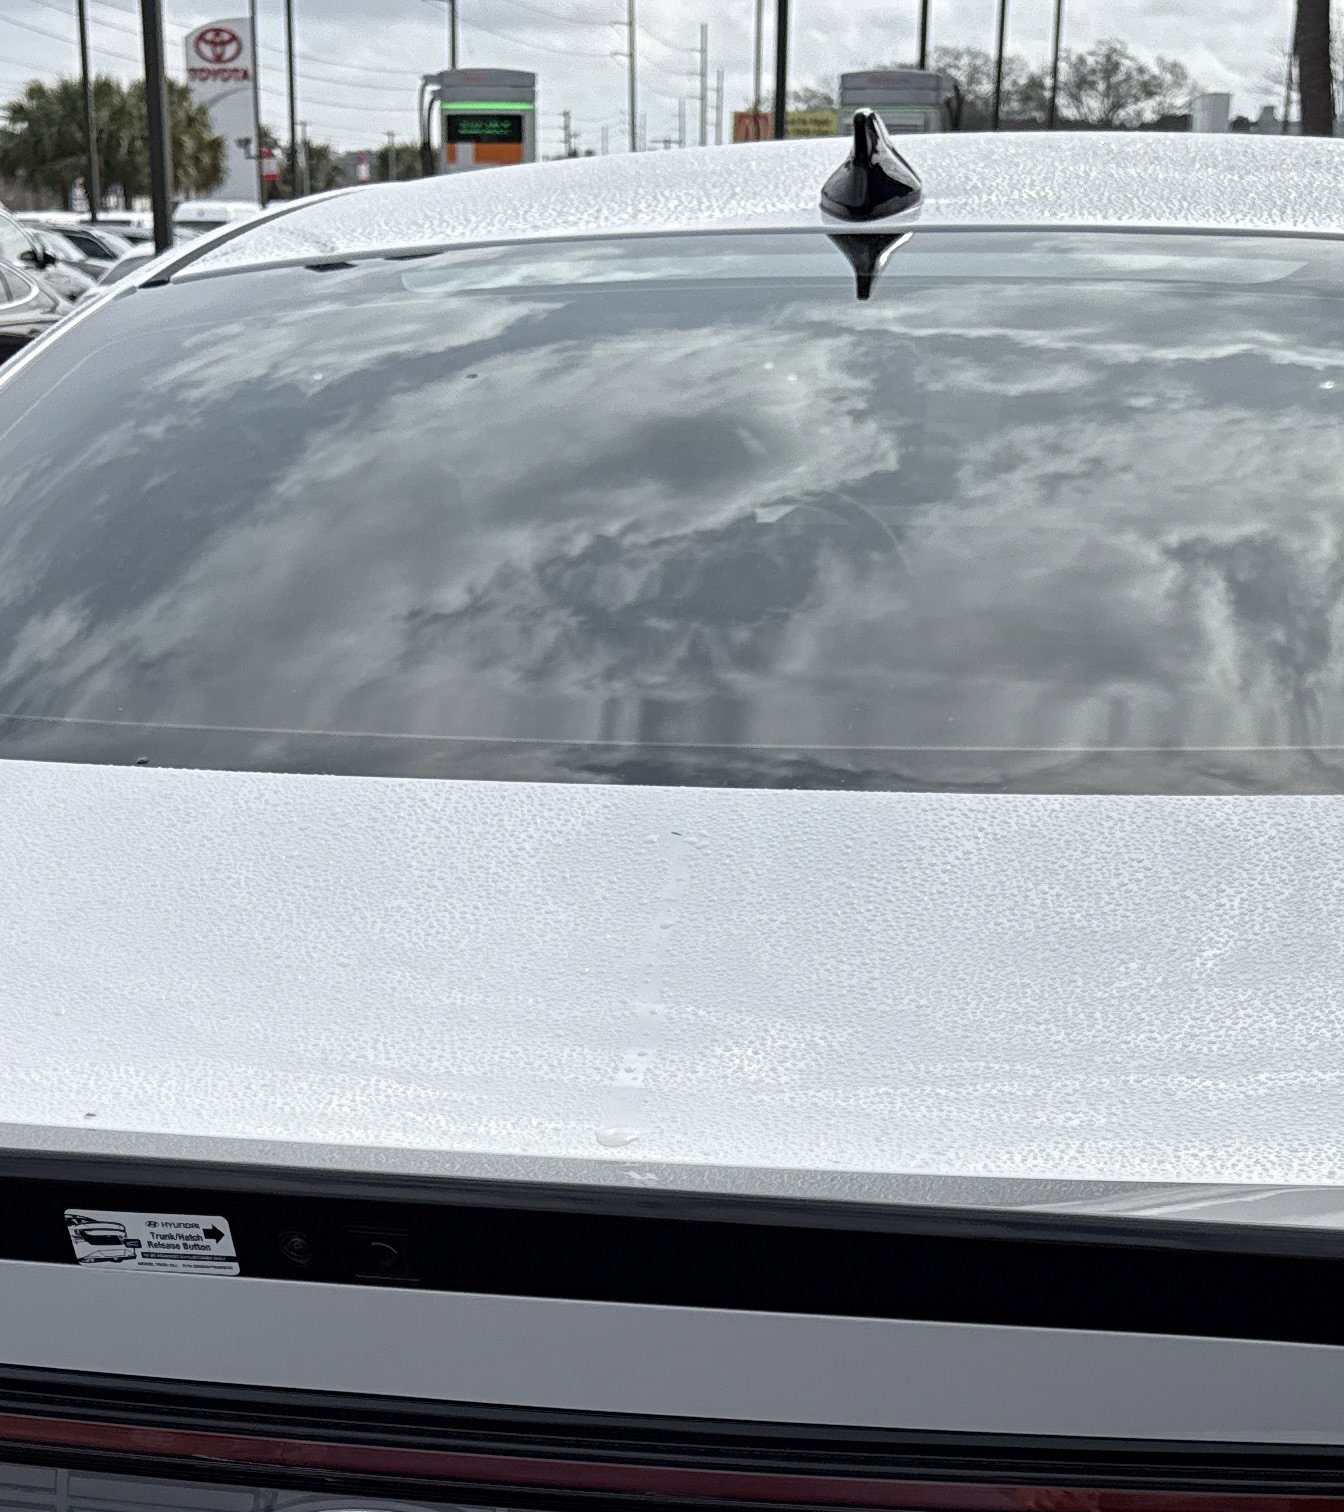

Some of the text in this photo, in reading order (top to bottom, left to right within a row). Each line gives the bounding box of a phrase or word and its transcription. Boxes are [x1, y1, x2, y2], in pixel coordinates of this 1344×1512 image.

[189, 67, 250, 82] TOYOTA
[150, 1232, 204, 1242] Trunk/Hatch
[147, 1240, 212, 1252] Release Button
